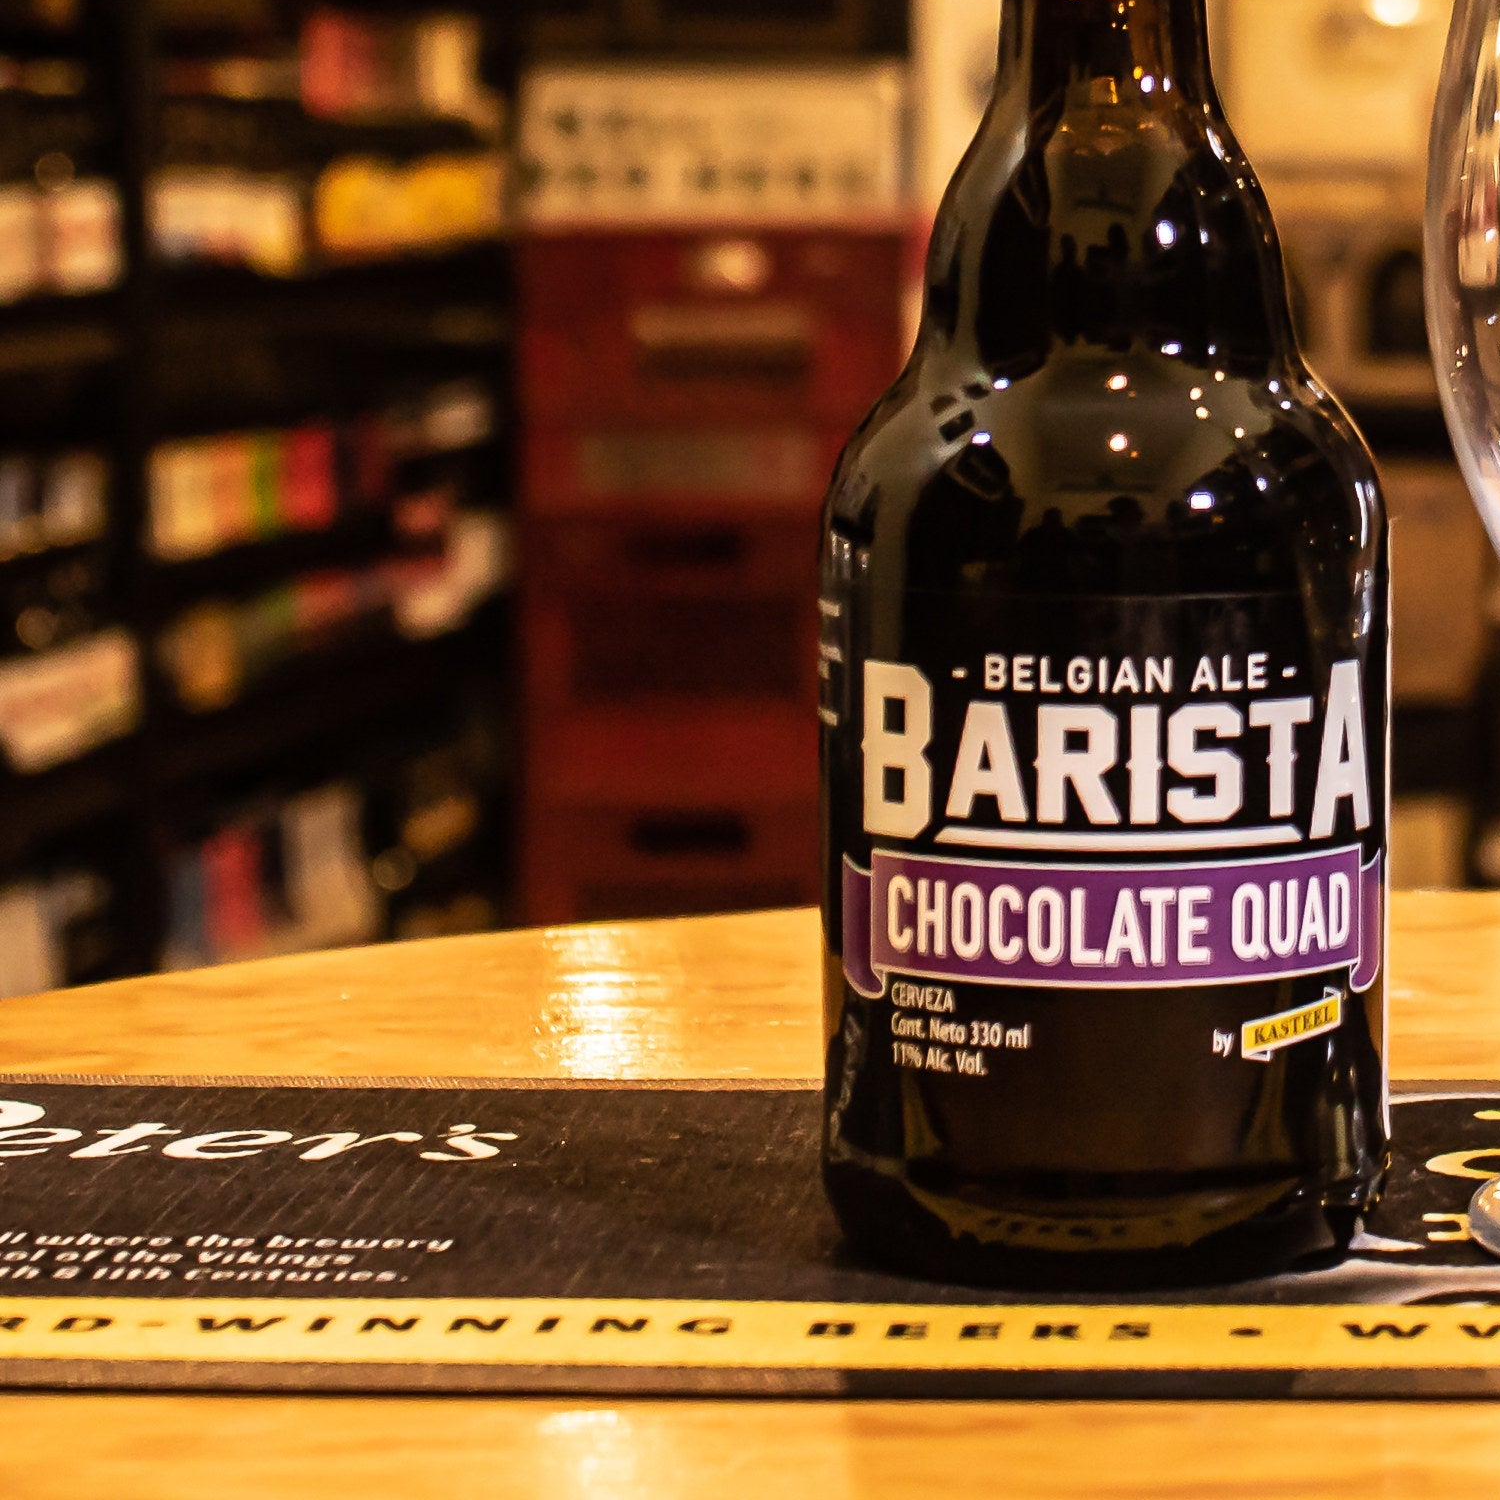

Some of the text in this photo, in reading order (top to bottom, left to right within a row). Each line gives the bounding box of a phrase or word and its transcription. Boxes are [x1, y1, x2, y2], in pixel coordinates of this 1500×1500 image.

[984, 652, 1269, 693] BELGIAN ALE
[861, 658, 1371, 840] BARISTA
[886, 870, 1352, 968] CHOCOLATE QUAD
[891, 980, 956, 1013] CERVEZA
[929, 1017, 967, 1044] Neto
[969, 1020, 1003, 1047] 330
[1005, 1022, 1031, 1049] ml
[1212, 1005, 1333, 1058] by KASTEEL
[892, 1040, 923, 1069] 11%
[955, 1050, 989, 1077] Vol.
[34, 1232, 174, 1246] where
[185, 1233, 256, 1248] the
[265, 1234, 455, 1253] brewery
[113, 1250, 184, 1265] the
[198, 1250, 356, 1269] Vikings
[805, 1320, 1153, 1341] BEERS
